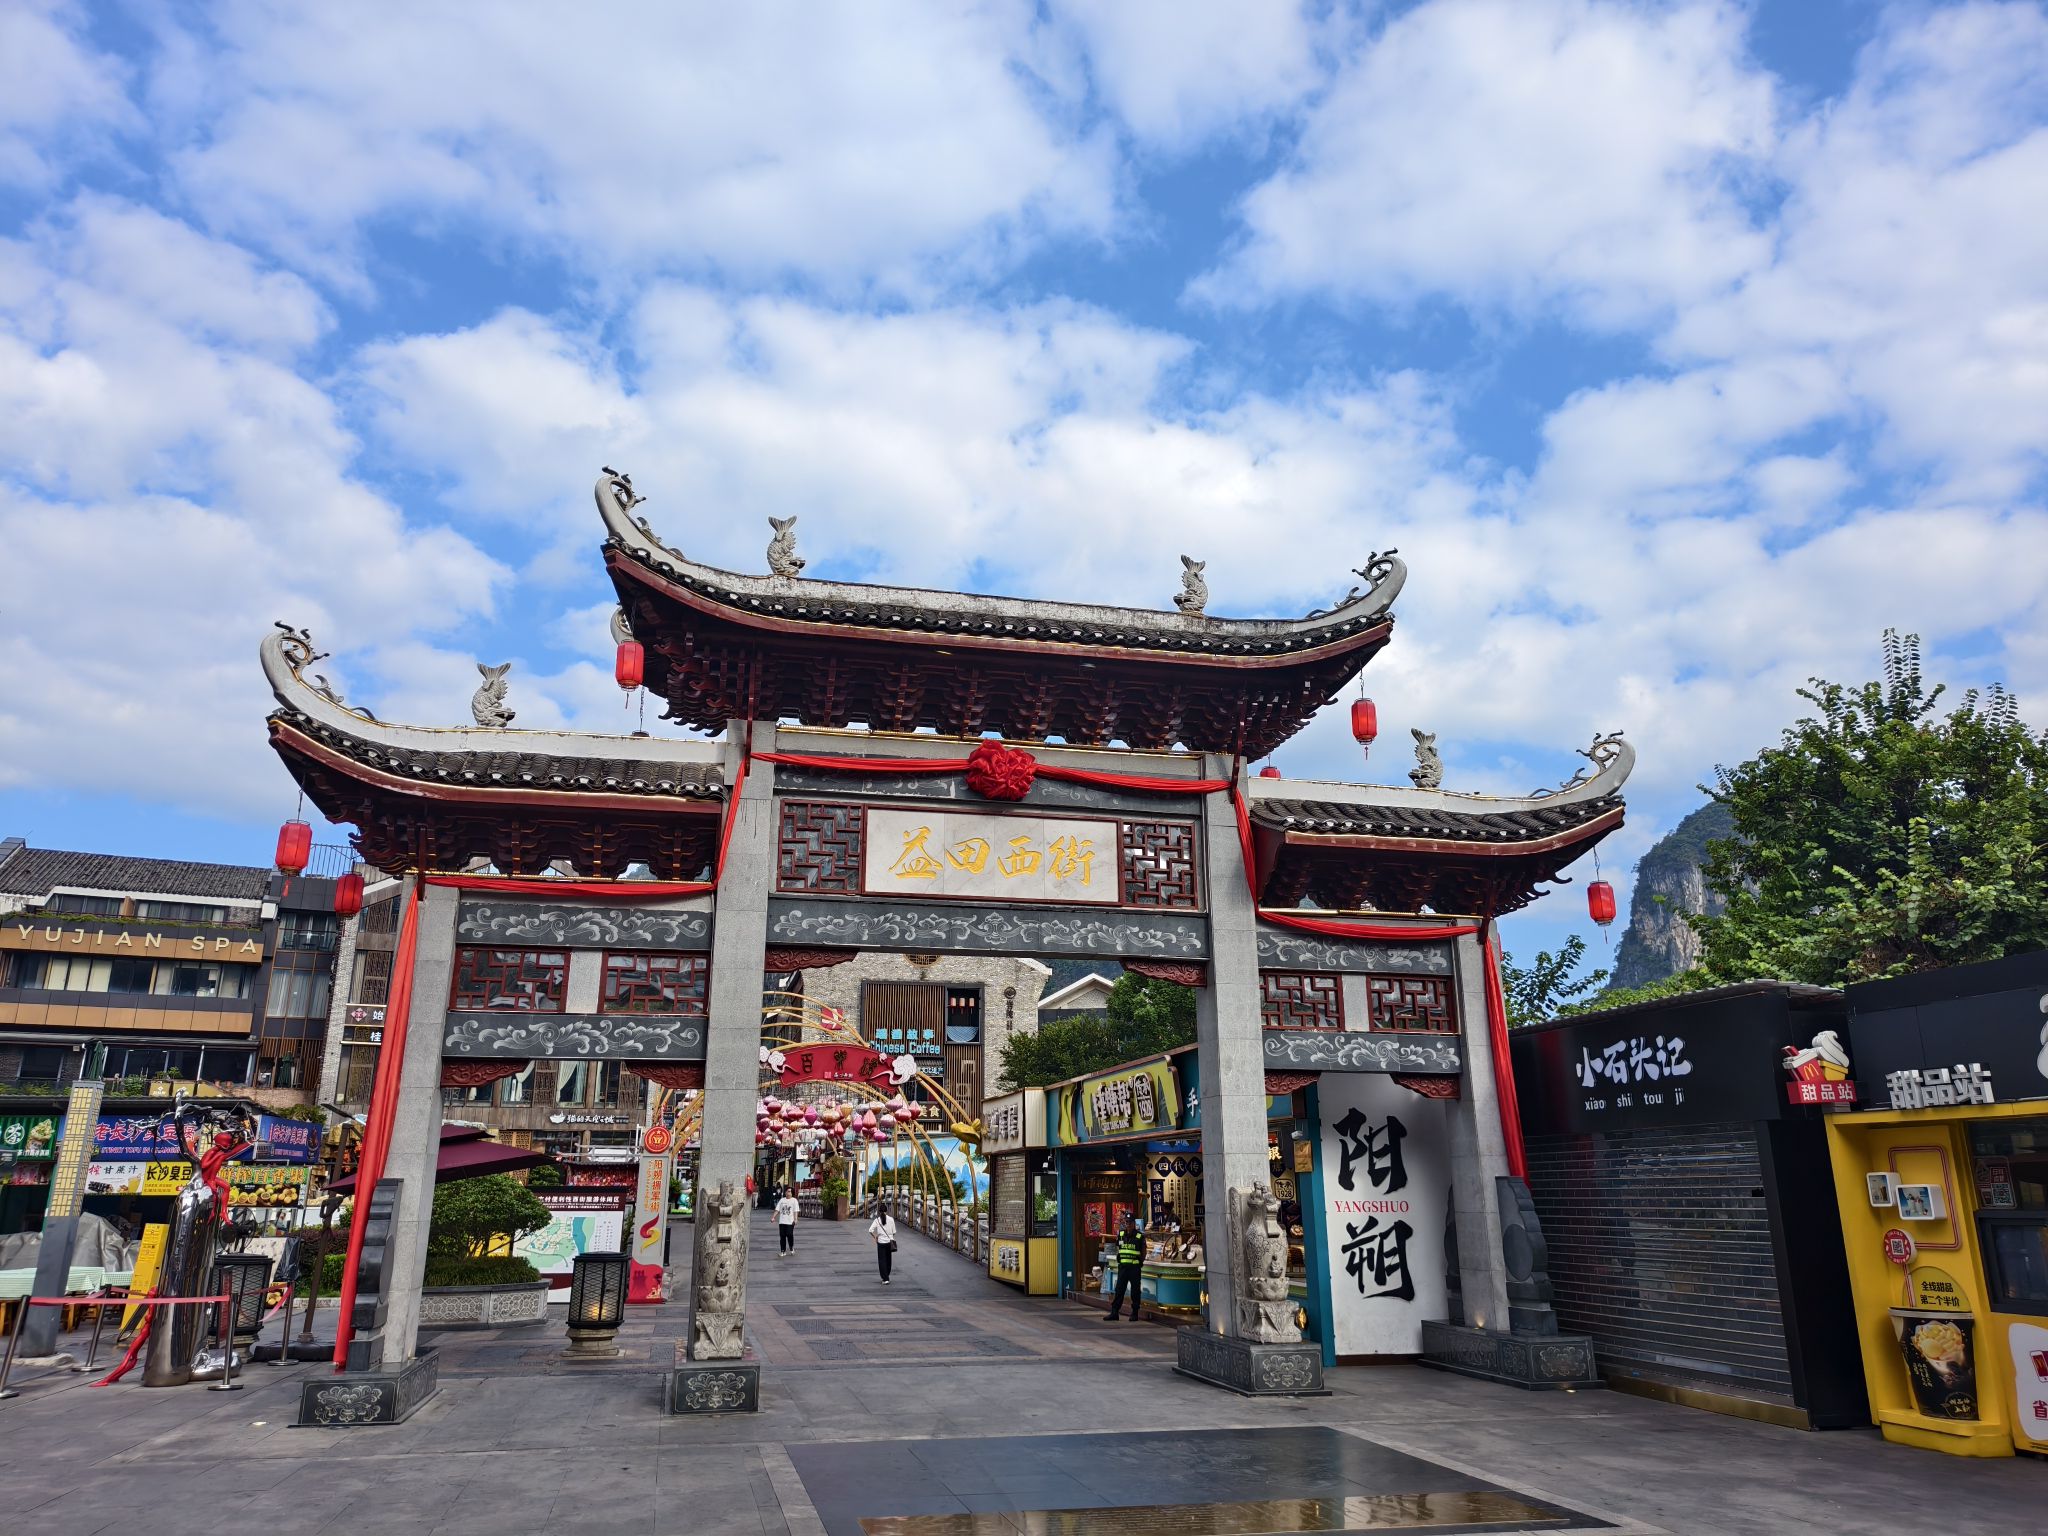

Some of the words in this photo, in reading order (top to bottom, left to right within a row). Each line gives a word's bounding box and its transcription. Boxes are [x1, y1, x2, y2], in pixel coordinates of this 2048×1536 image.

[888, 825, 1096, 887] 益田西街
[18, 924, 162, 949] YUJIAN
[191, 935, 257, 954] SPA
[370, 1031, 381, 1042] 桂
[869, 1041, 905, 1053] Chinese
[909, 1042, 940, 1054] Coffee
[1576, 1035, 1693, 1088] 小石头记
[1802, 1082, 1854, 1102] 甜品站
[1886, 1061, 1994, 1110] 甜品站
[1585, 1096, 1605, 1111] xiao
[1617, 1093, 1632, 1108] shi
[1643, 1091, 1663, 1106] tou
[1675, 1088, 1684, 1106] ji
[919, 1104, 940, 1118] 美食
[567, 1114, 615, 1124] 猫的天空之城
[1278, 1190, 1293, 1198] 1928
[1335, 1200, 1409, 1214] YANGSHUO
[1921, 1281, 1954, 1293] 全线甜品
[1920, 1294, 1960, 1307] 第二个半价
[2032, 1399, 2048, 1420] 省
